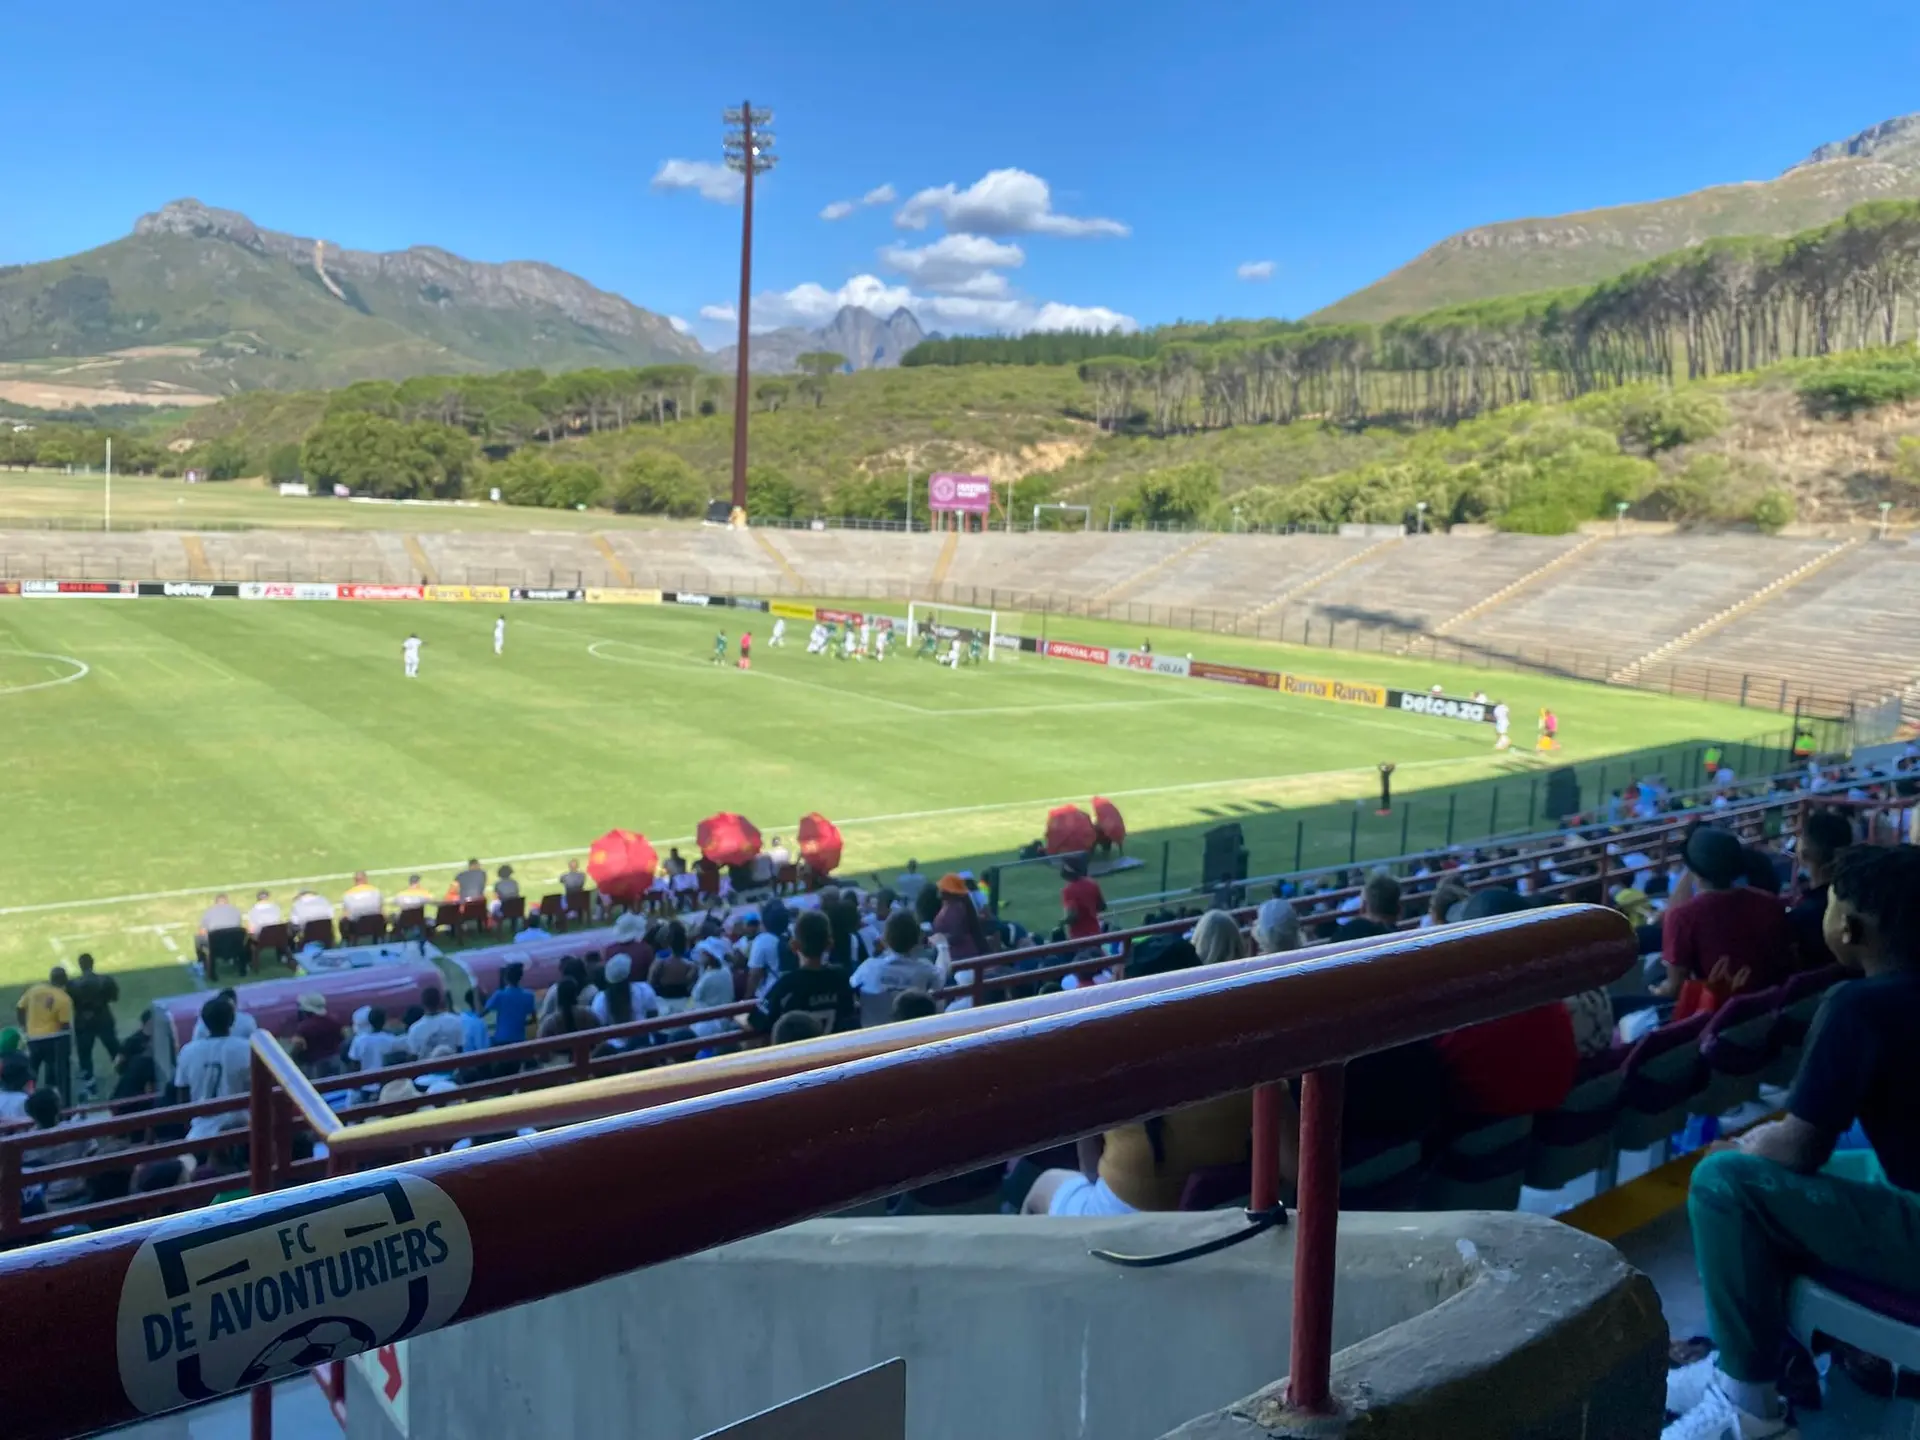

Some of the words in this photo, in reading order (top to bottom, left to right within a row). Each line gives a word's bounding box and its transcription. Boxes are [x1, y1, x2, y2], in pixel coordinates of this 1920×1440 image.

[1284, 675, 1327, 696] Rama
[1332, 681, 1377, 704] Rama
[277, 1222, 316, 1261] FC
[142, 1302, 197, 1363] DE
[208, 1220, 449, 1341] AVONTURIERS
